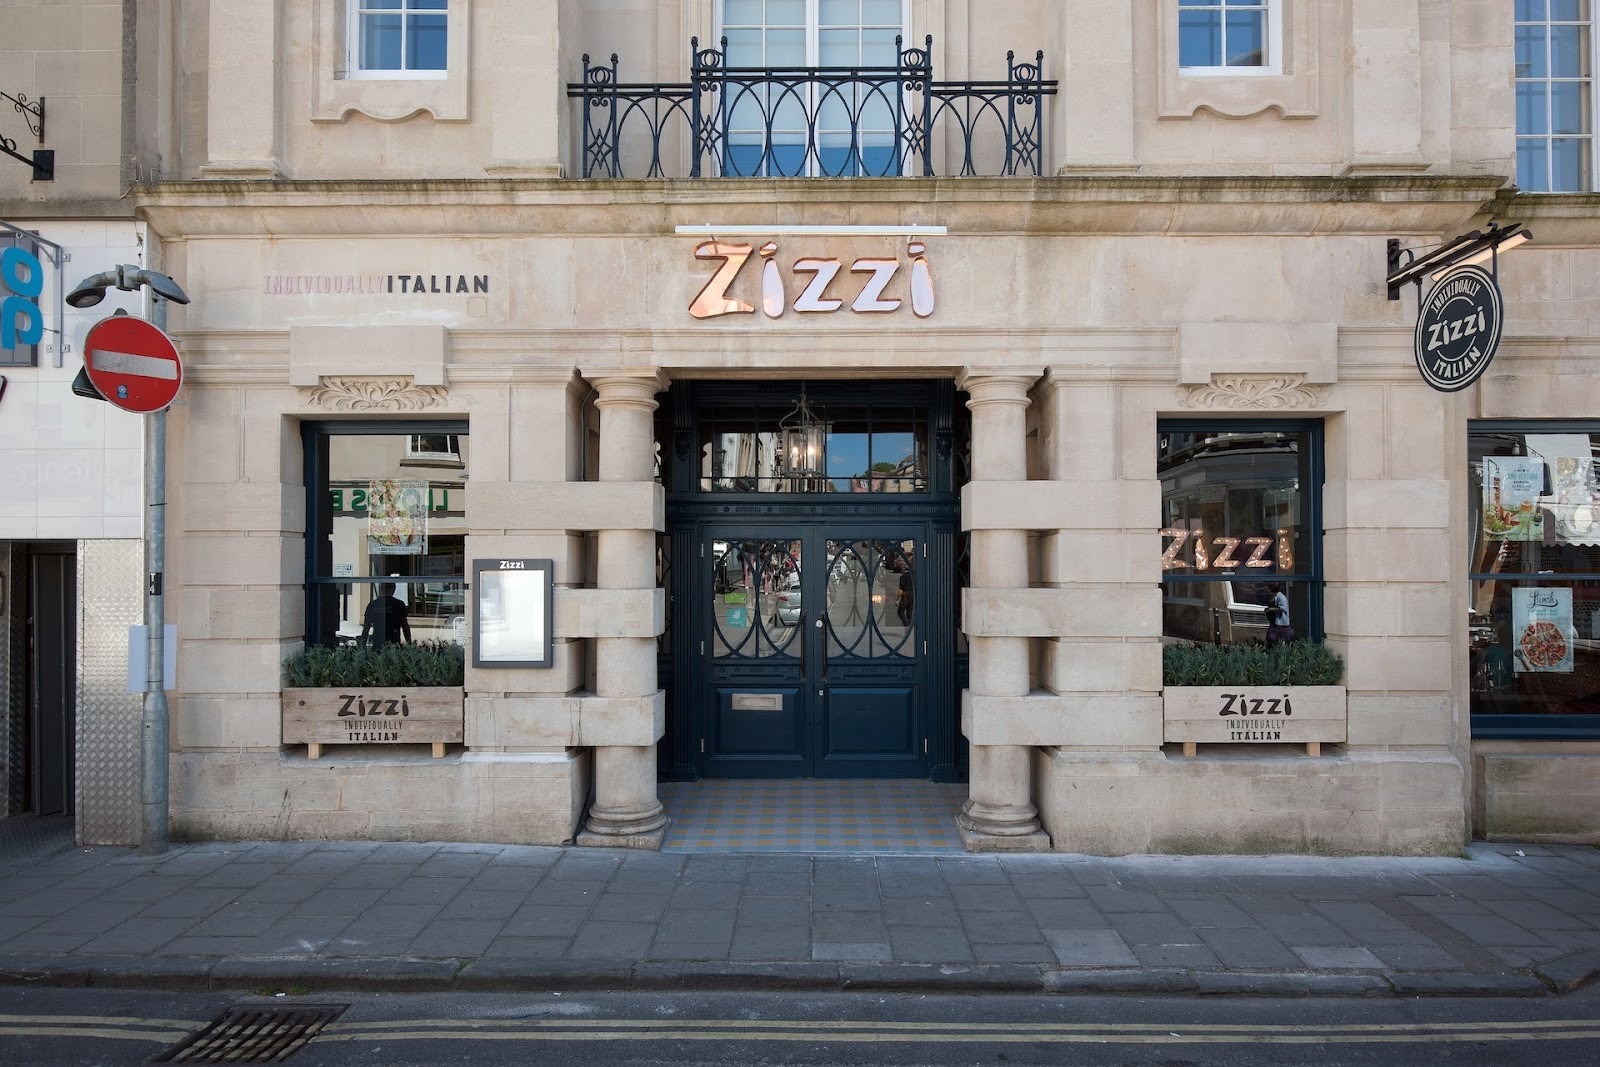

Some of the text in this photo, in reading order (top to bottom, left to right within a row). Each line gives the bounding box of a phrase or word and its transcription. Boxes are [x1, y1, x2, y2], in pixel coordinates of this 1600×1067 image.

[387, 275, 489, 293] ITALIAN
[688, 240, 935, 320] Zizzi
[1431, 279, 1480, 314] INDIVIDUALLY
[1427, 305, 1486, 351] Zizzi
[1433, 345, 1481, 378] ITALIAN
[1159, 528, 1293, 571] Zizzi
[499, 560, 525, 570] Zizzi
[337, 694, 409, 717] Zizzi
[1219, 693, 1292, 716] Zizzi
[344, 720, 403, 730] INDIVIDUALLY
[1226, 719, 1286, 729] INDIVIDUALLY
[1231, 731, 1281, 740] ITALIAN
[349, 732, 398, 741] ITALIAN
